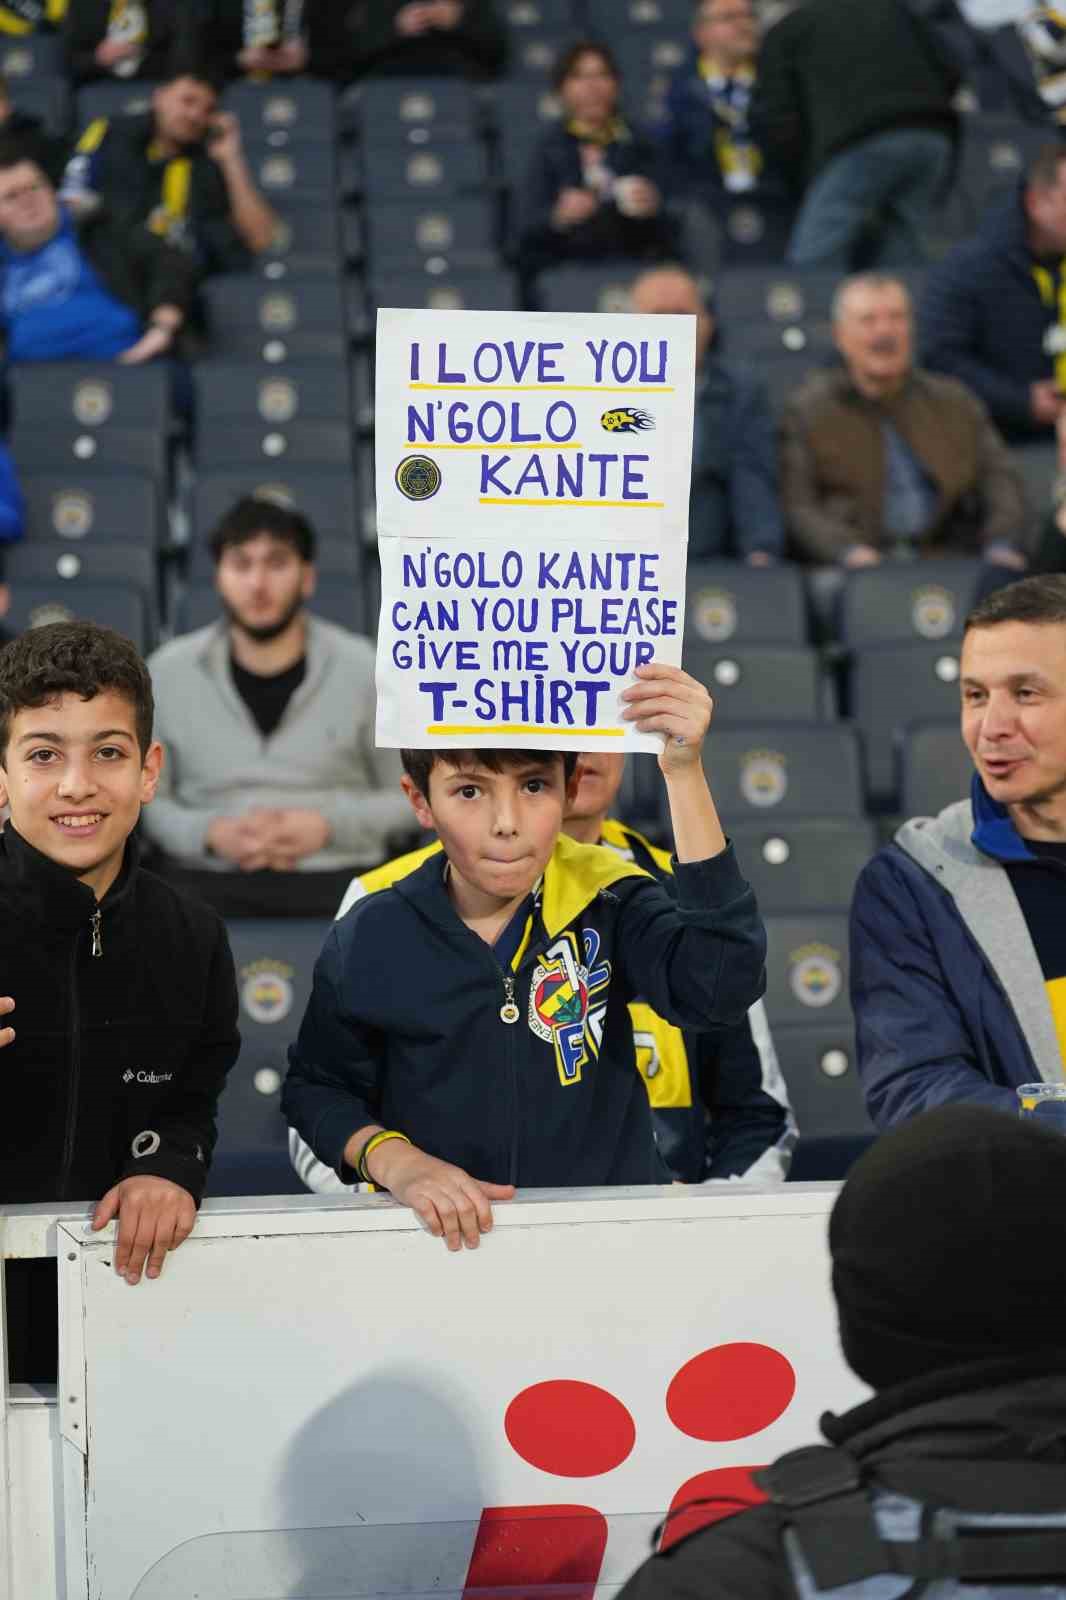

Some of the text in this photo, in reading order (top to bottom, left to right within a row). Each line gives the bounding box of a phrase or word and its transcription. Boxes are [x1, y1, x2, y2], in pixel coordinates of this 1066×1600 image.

[410, 340, 668, 383] I LOVE YOU
[407, 400, 577, 443] N'GOLO
[479, 452, 650, 500] KANTE
[403, 546, 660, 592] N'GOLO KANTE
[391, 597, 678, 636] CAN YOU PLEASE
[560, 639, 655, 676] YOUR
